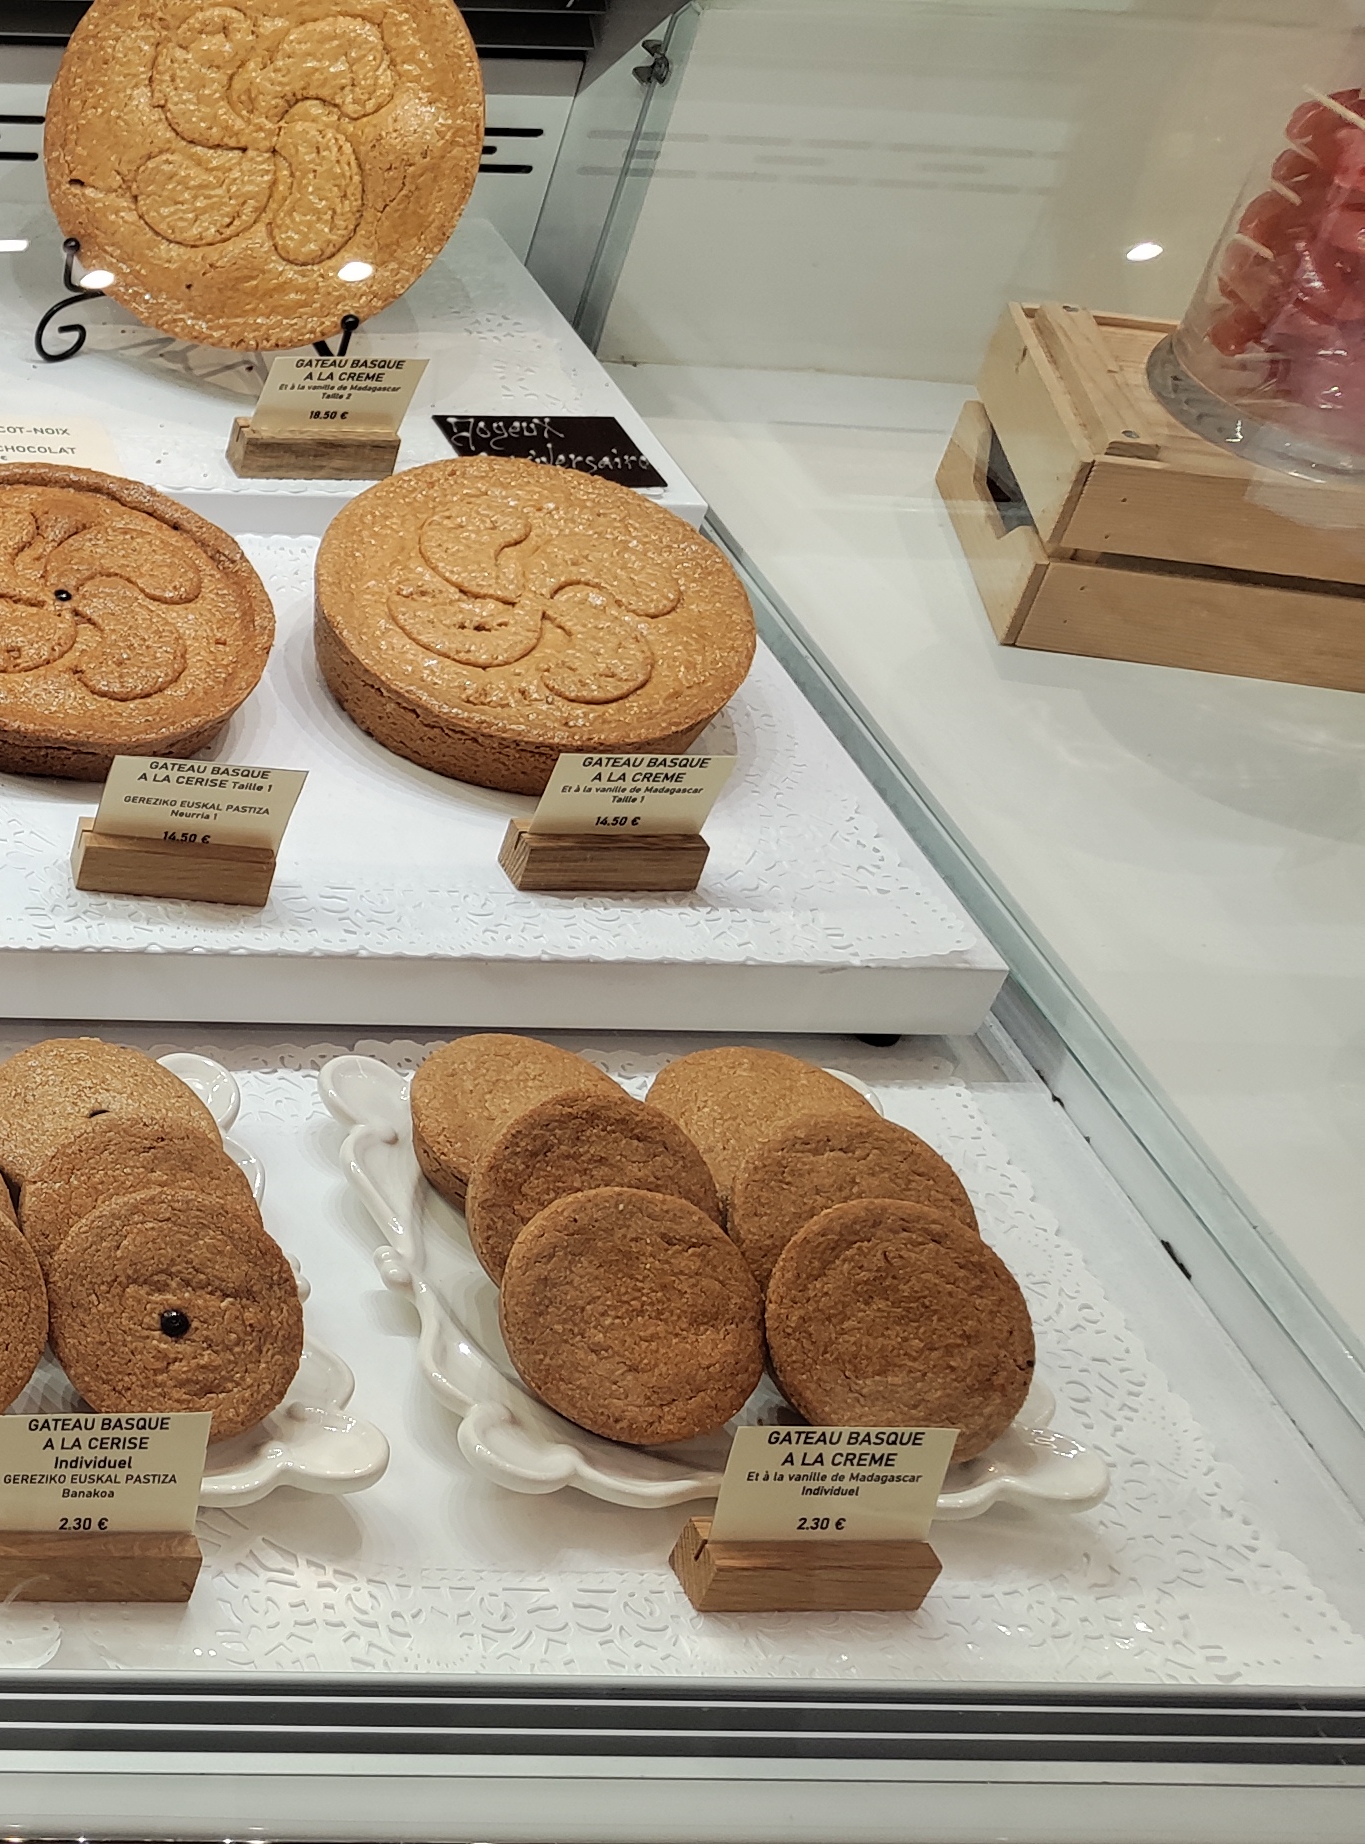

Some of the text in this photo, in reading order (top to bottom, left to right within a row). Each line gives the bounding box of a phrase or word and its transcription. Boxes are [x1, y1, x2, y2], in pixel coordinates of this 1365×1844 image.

[304, 372, 385, 382] A LA CREME
[595, 817, 640, 826] 14.50 €
[768, 1431, 925, 1446] GATEAU BASQUE
[54, 1457, 132, 1469] Individuel
[781, 1453, 897, 1467] A LA CREME
[3, 1474, 177, 1484] GEREZIKO EUSKAL PASTIZA
[747, 1471, 922, 1484] Et à la vanille de Madagascar
[801, 1486, 859, 1496] Individuel
[59, 1518, 108, 1530] 2.30 €
[797, 1518, 846, 1530] 2.30 €
